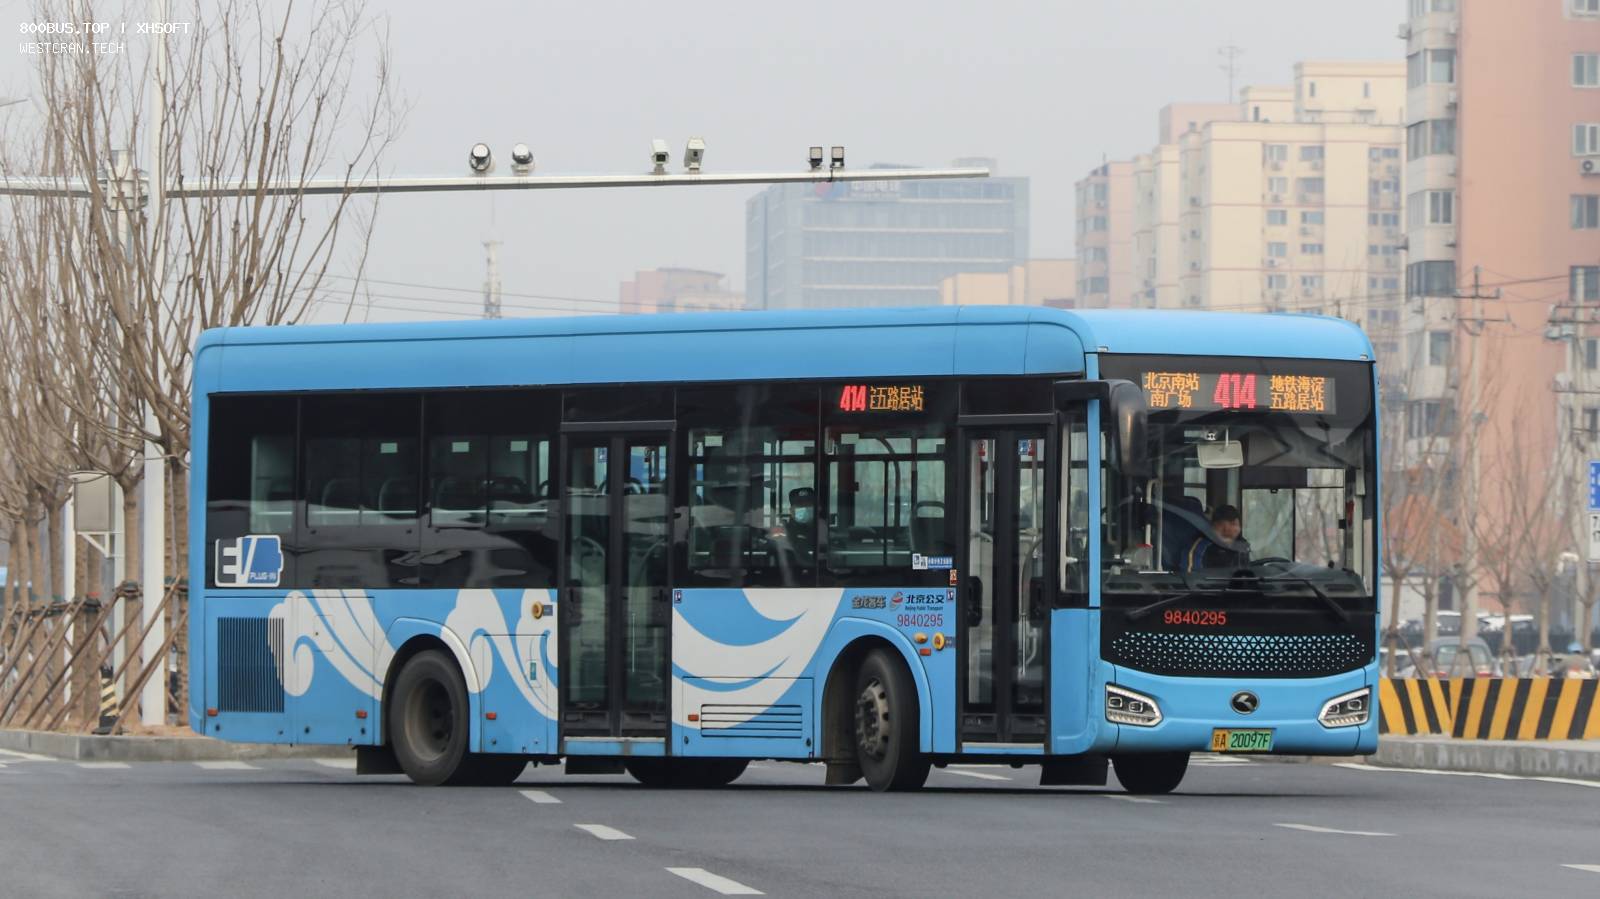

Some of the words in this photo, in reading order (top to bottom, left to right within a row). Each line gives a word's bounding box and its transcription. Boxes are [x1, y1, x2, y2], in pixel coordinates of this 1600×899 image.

[1144, 372, 1199, 391] 北京南站
[1270, 375, 1325, 393] 地铁海淀
[839, 385, 867, 411] 414
[1150, 390, 1192, 408] 南广场
[1213, 373, 1257, 409] 414
[1270, 392, 1325, 411] 五路居站
[906, 594, 944, 604] 北京公交
[897, 614, 943, 627] 9840295
[1164, 611, 1227, 625] 9840295
